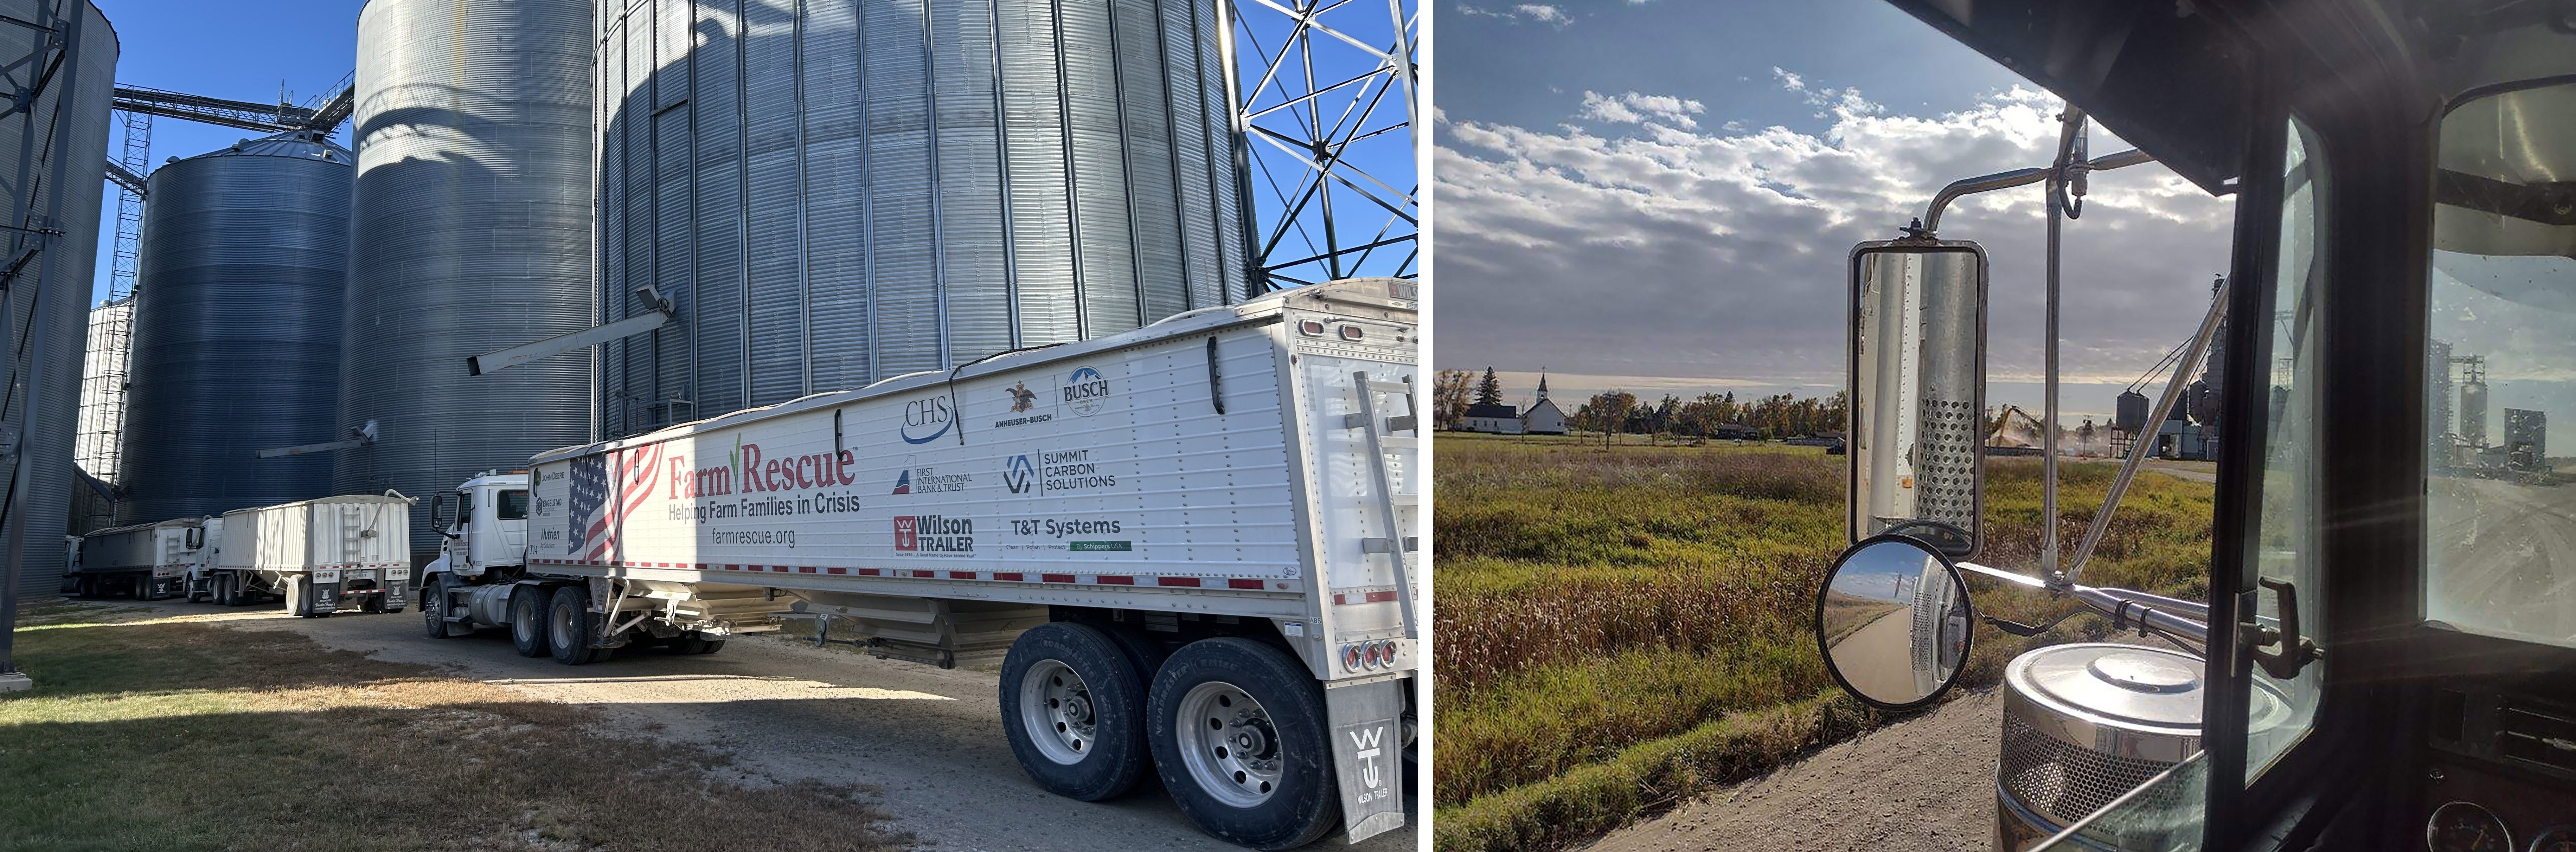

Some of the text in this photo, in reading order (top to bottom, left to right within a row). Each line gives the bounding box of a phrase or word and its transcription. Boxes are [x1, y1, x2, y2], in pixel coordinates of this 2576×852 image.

[1397, 285, 1418, 299] WILS
[1064, 380, 1109, 402] BUSCH
[905, 396, 948, 426] CHS
[995, 414, 1052, 428] ANHEUSER-BUSCH
[1044, 450, 1088, 464] SUMMIT
[669, 455, 731, 499] Farm
[741, 444, 856, 493] Rescue
[917, 467, 933, 477] FIRST
[1045, 463, 1095, 477] CARBON
[542, 474, 552, 482] JOHN
[917, 473, 972, 485] INTERNATIONAL
[1046, 475, 1116, 490] SOLUTIONS
[543, 498, 562, 507] ENGELSTAD
[669, 490, 860, 524] Helping Farm Families in Crisis
[917, 515, 972, 535] Wilson
[1011, 518, 1121, 538] T&T Systems
[541, 528, 560, 540] Nutrien
[712, 528, 795, 549] farmrescue.org
[918, 537, 973, 551] TRAILER
[1357, 788, 1388, 805] WILSON TRAILER
